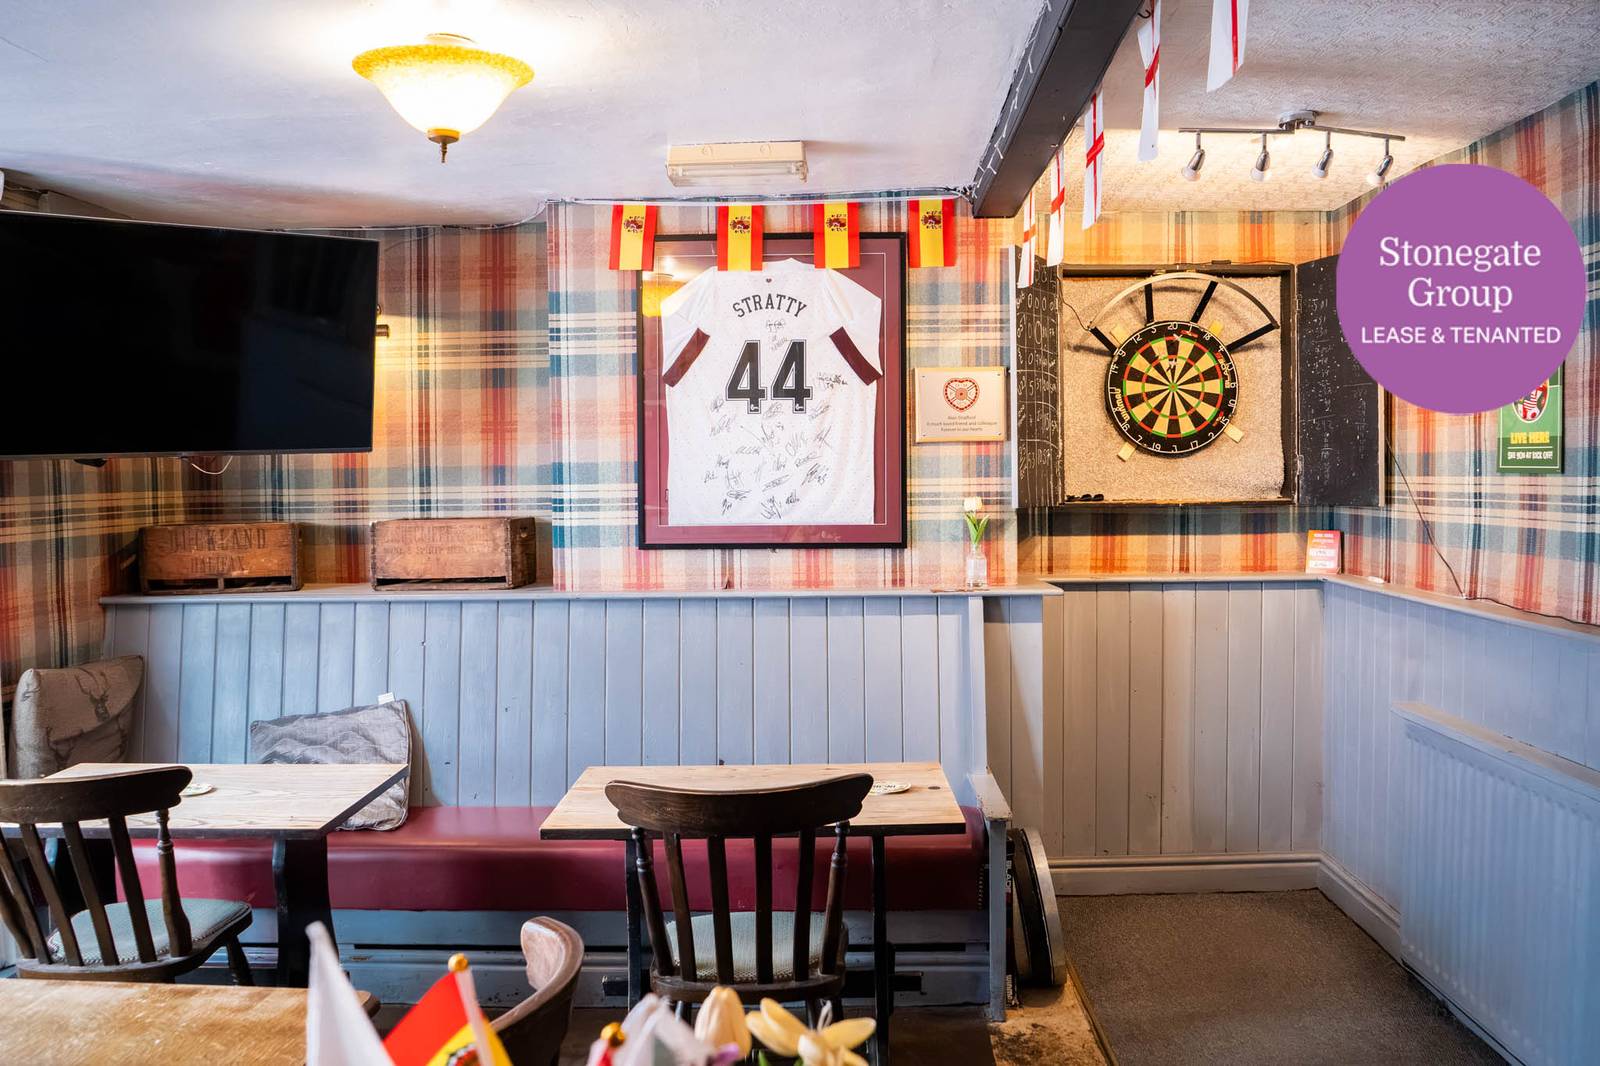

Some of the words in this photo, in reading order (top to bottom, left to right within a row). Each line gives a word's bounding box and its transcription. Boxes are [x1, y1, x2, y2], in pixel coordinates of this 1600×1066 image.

[732, 293, 807, 318] STRATTY
[1167, 322, 1178, 330] 20
[1132, 333, 1142, 344] 12
[1203, 332, 1211, 341] 18
[1110, 363, 1119, 374] 14
[725, 339, 813, 414] 44
[1120, 421, 1130, 431] 16
[1220, 416, 1230, 426] 15
[1510, 432, 1527, 444] LIVE
[1151, 442, 1161, 451] 19
[1190, 440, 1199, 450] 17
